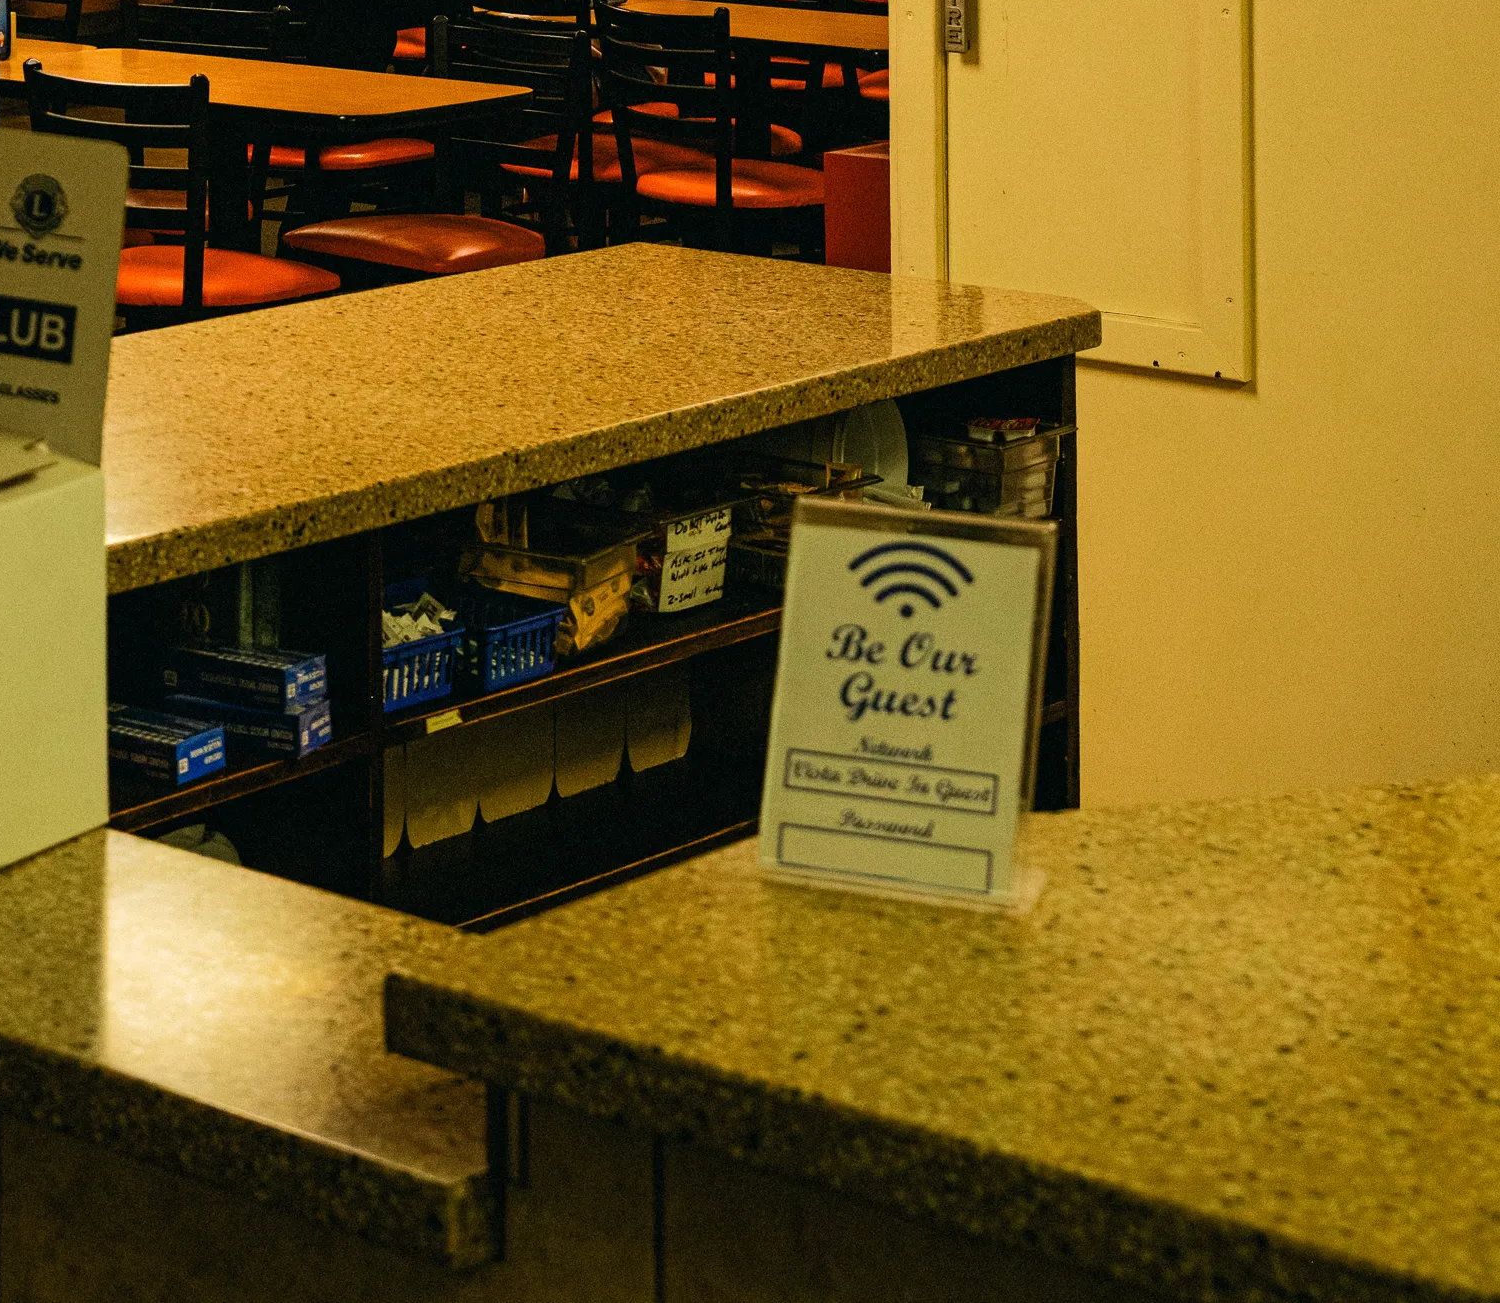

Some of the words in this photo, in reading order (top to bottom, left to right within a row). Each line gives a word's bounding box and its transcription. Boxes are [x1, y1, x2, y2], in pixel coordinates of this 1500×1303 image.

[22, 245, 84, 272] Serve
[826, 623, 886, 665] Be
[899, 630, 982, 677] Our
[839, 672, 958, 722] Guest
[853, 735, 935, 763] Network
